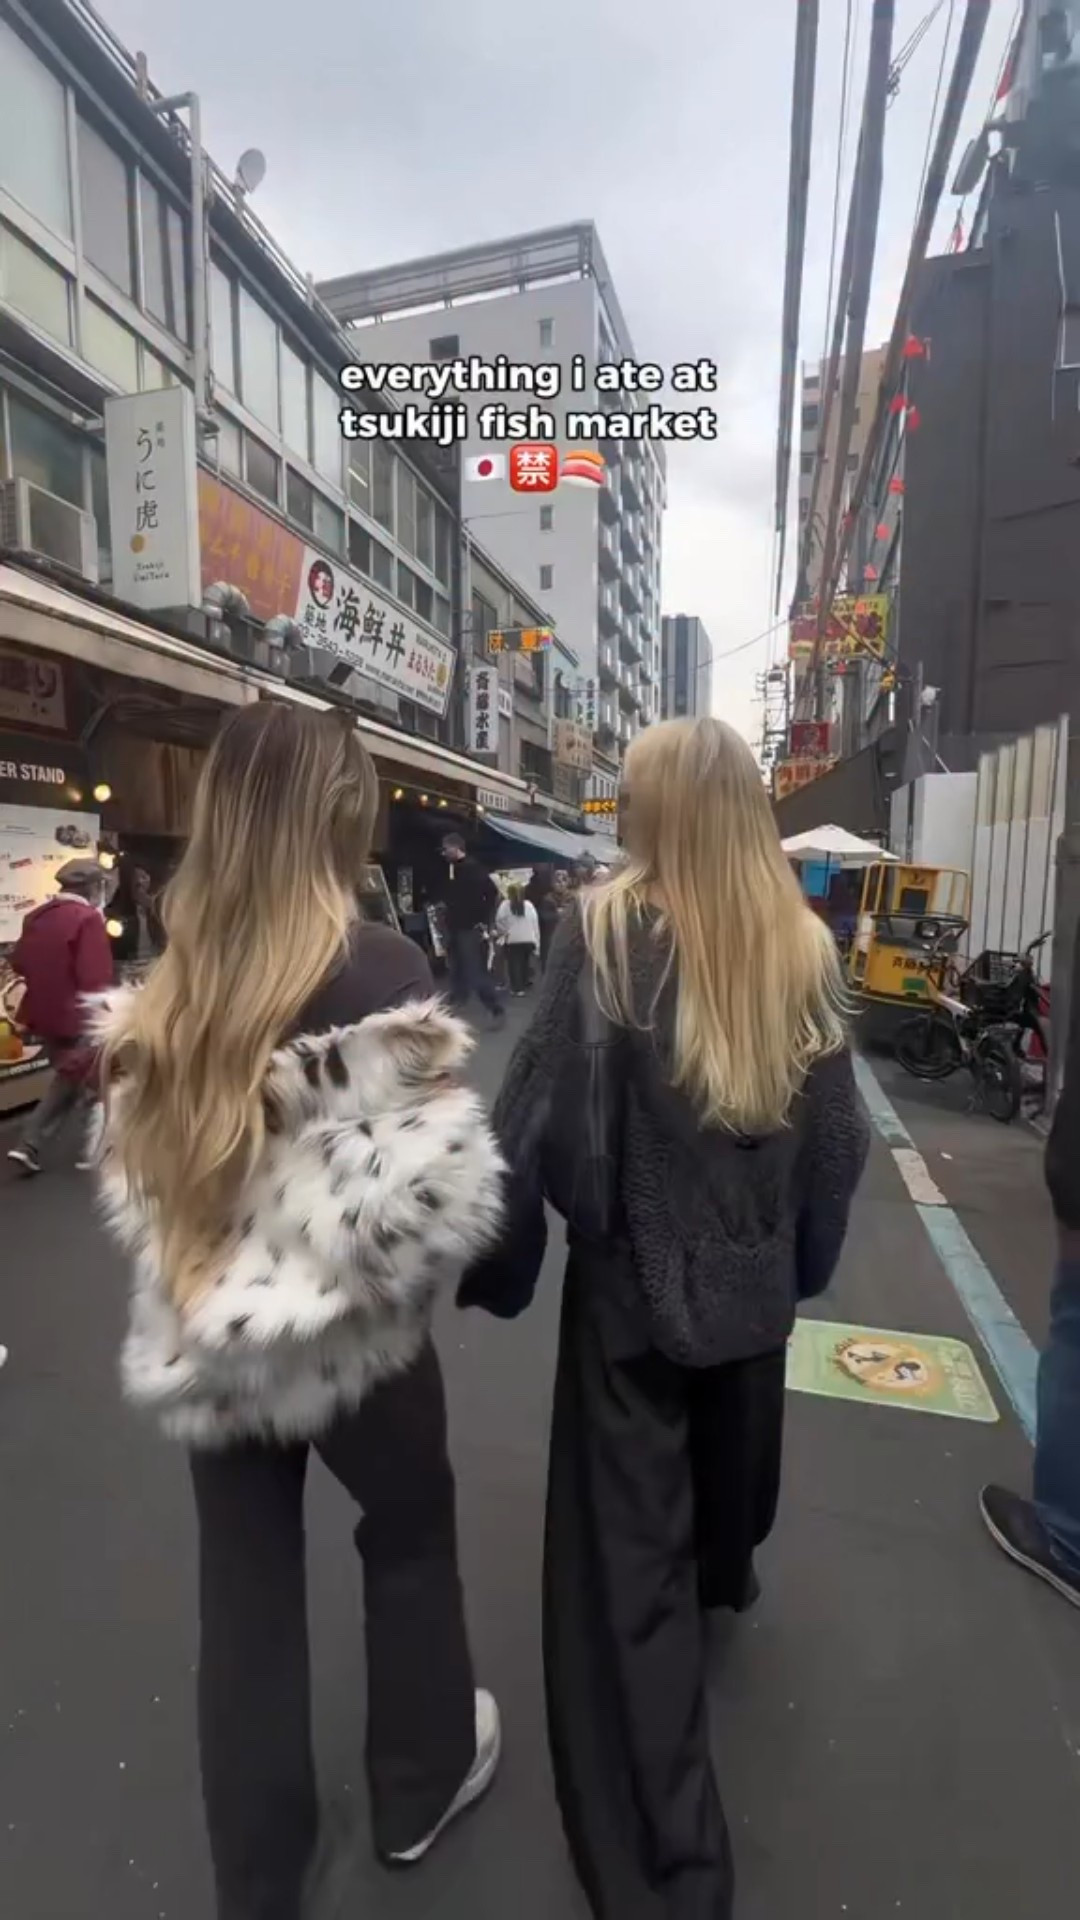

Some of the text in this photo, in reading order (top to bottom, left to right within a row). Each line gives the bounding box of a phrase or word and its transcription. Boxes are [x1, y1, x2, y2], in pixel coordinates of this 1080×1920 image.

[136, 427, 159, 532] うに虎
[333, 585, 405, 669] 海鮮丼
[407, 648, 435, 681] まるきた
[20, 762, 65, 785] STAND
